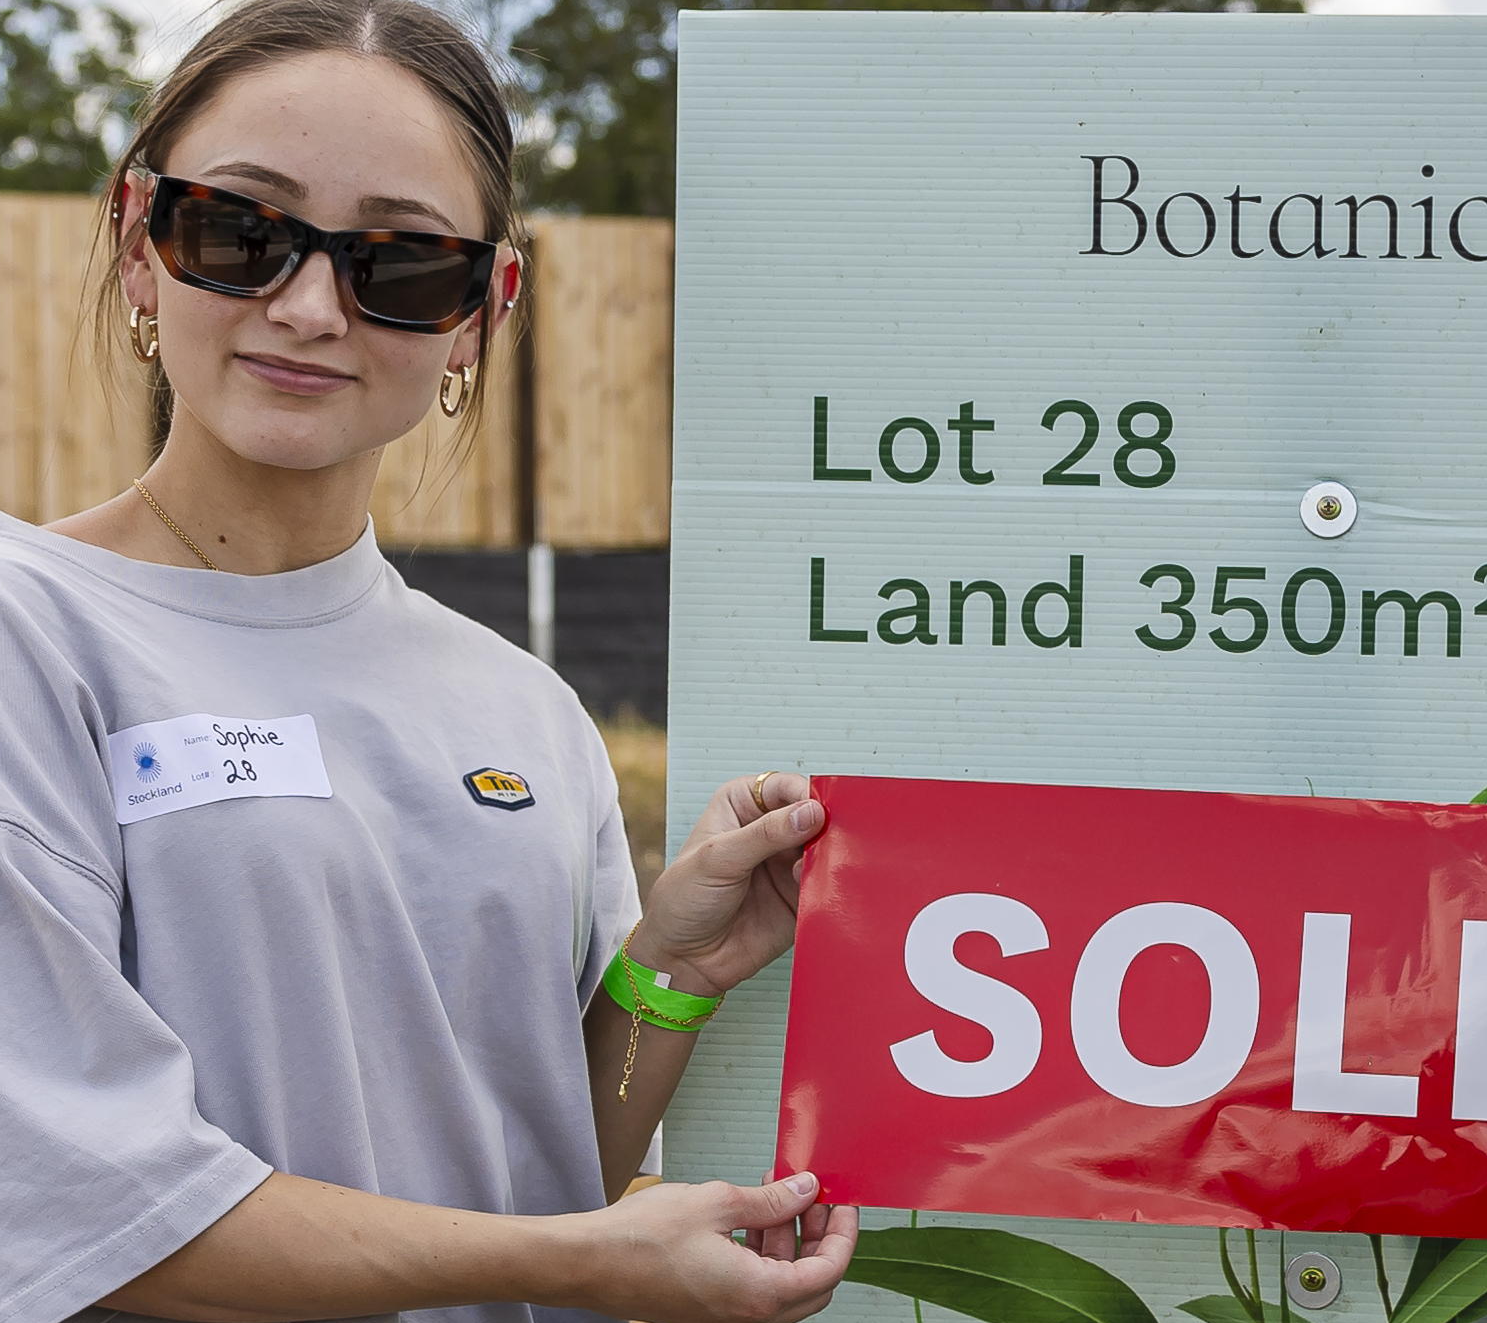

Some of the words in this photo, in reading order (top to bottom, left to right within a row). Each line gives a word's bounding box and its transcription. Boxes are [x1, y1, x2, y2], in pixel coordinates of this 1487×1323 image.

[811, 394, 996, 486] Lot
[1039, 398, 1177, 490] 28
[808, 553, 1085, 650] Land
[212, 723, 285, 753] Sophie
[222, 759, 258, 784] 28
[484, 776, 515, 791] Tn
[127, 782, 183, 806] Stockland
